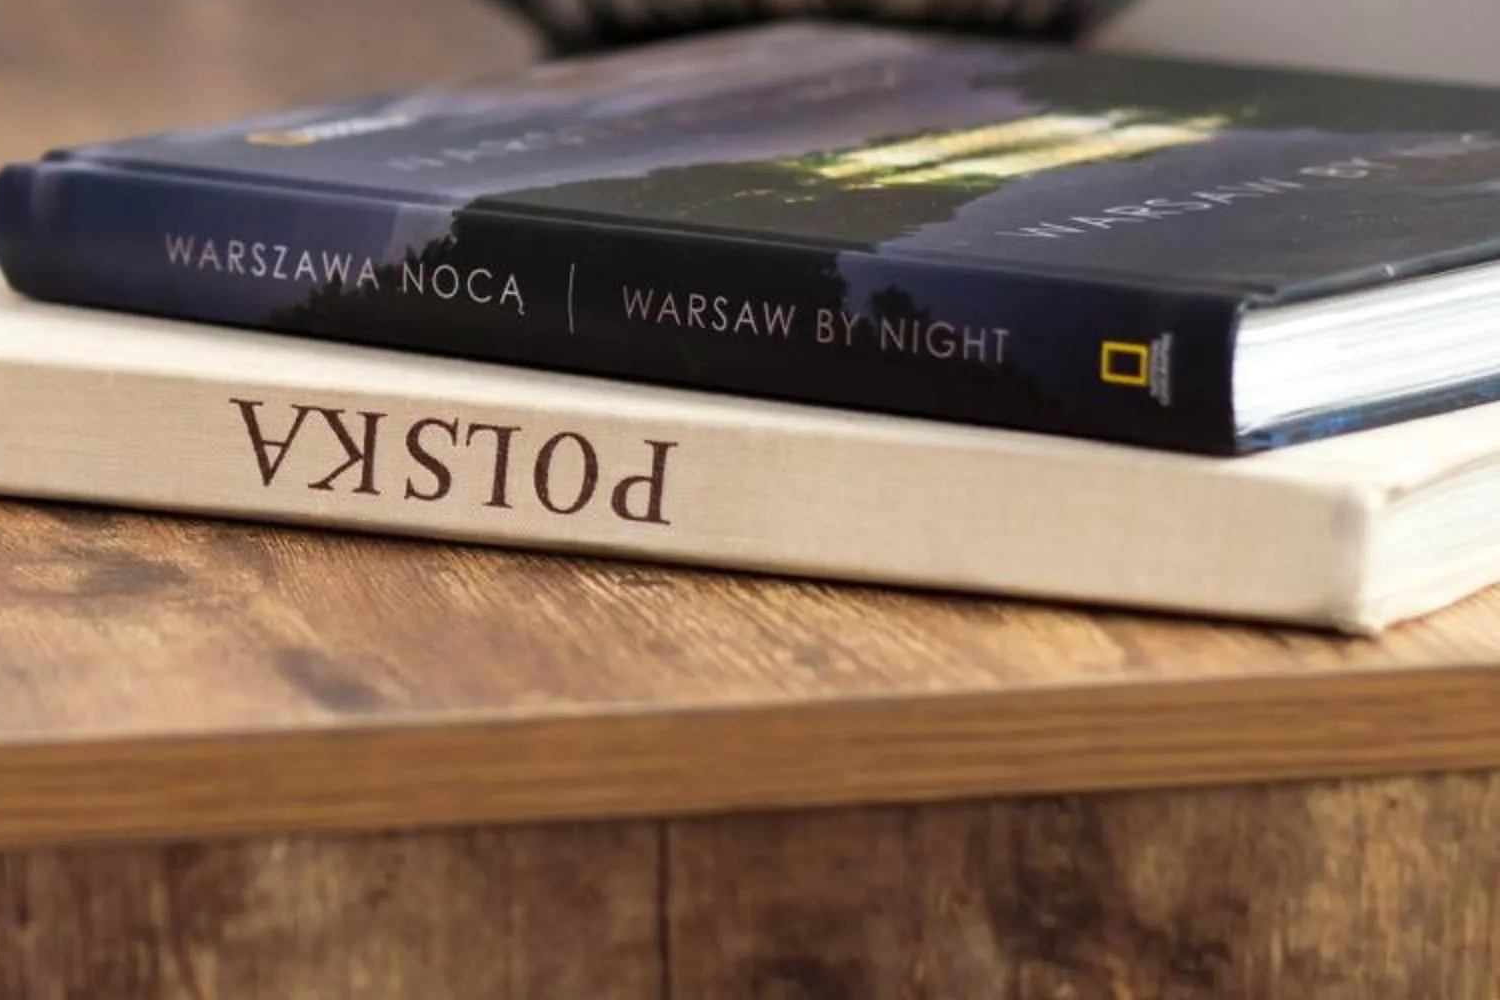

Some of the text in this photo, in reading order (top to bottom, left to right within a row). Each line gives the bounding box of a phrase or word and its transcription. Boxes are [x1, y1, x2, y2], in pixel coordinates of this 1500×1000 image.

[994, 176, 1303, 239] WARSAW
[164, 232, 1012, 364] WARSZAWA NOCĄ WARSAW BY NIGHT
[228, 398, 679, 526] POLSKA
